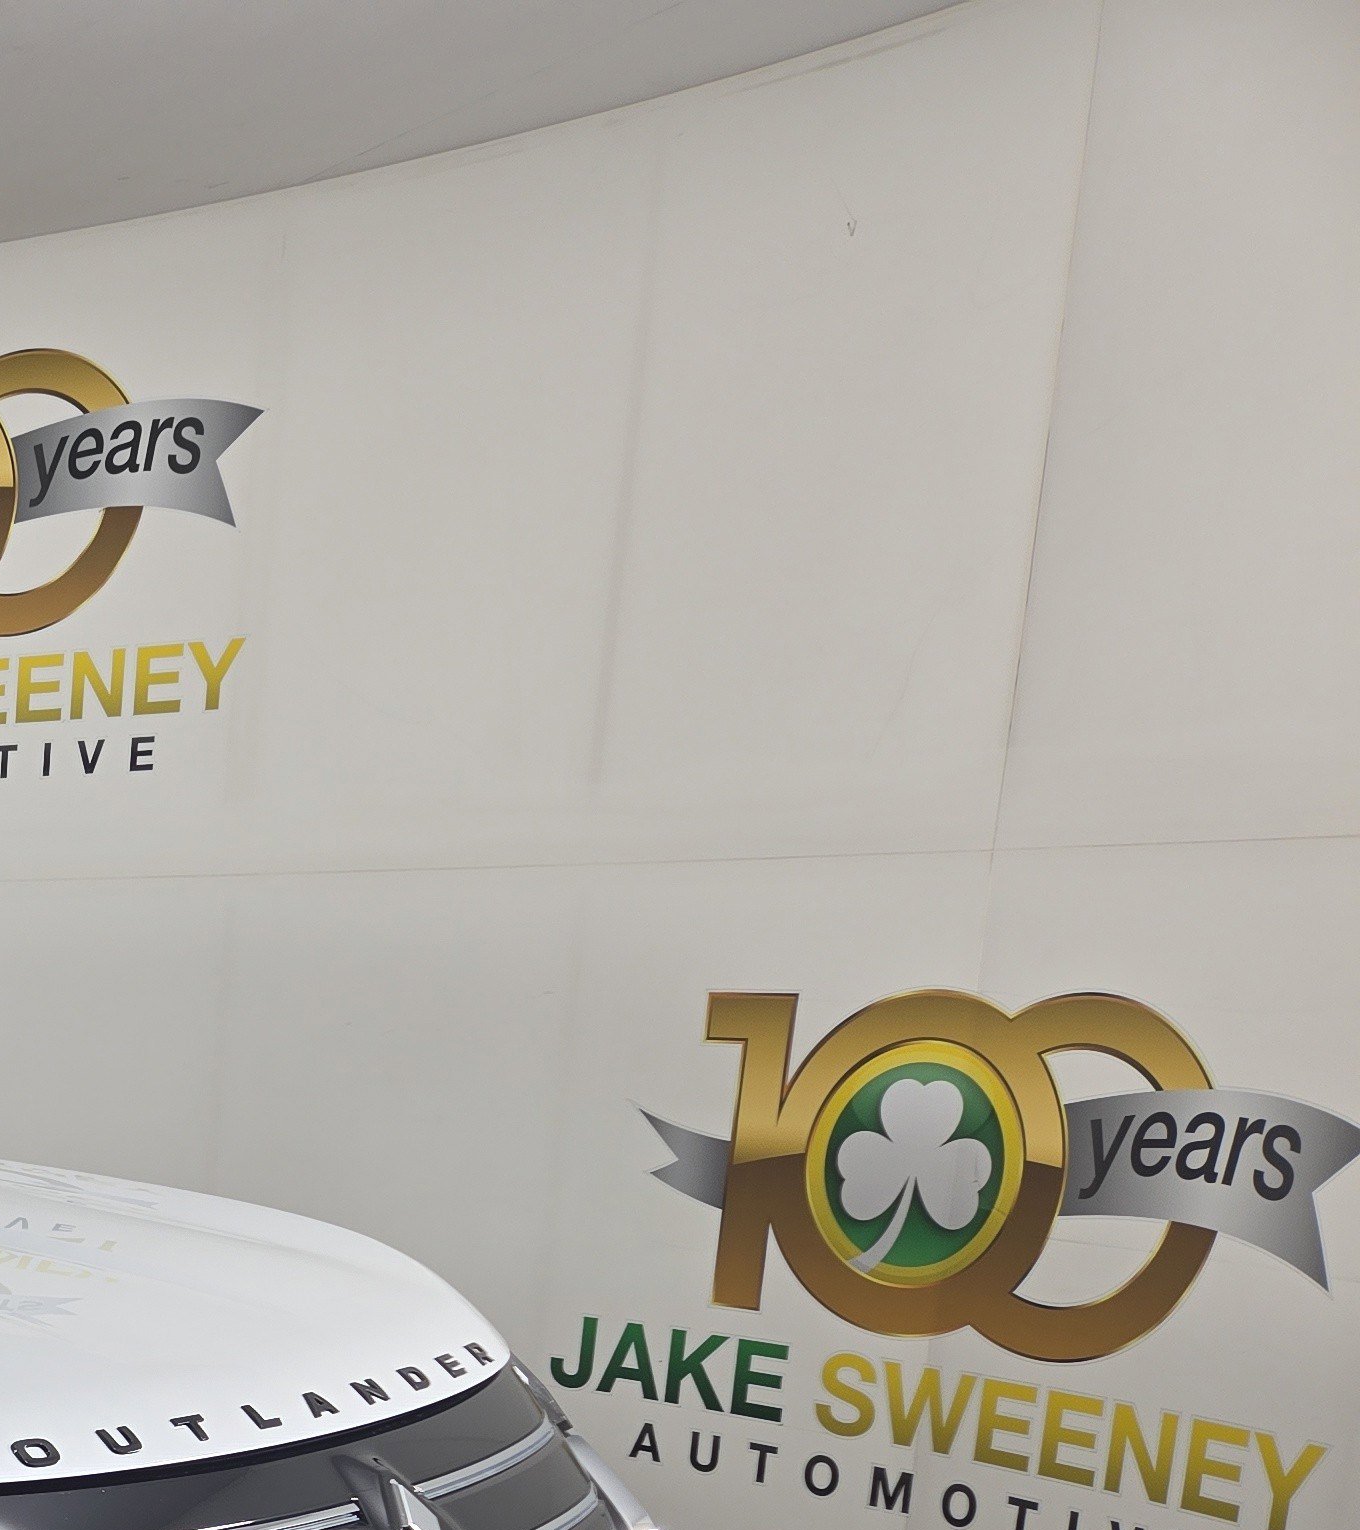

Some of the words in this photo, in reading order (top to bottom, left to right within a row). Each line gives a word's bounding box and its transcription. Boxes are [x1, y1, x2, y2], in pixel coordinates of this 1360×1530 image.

[29, 414, 205, 508] years
[705, 989, 1218, 1363] 100
[1079, 1110, 1302, 1200] years
[10, 1341, 497, 1468] OUTLANDER
[551, 1315, 790, 1423] JAKE
